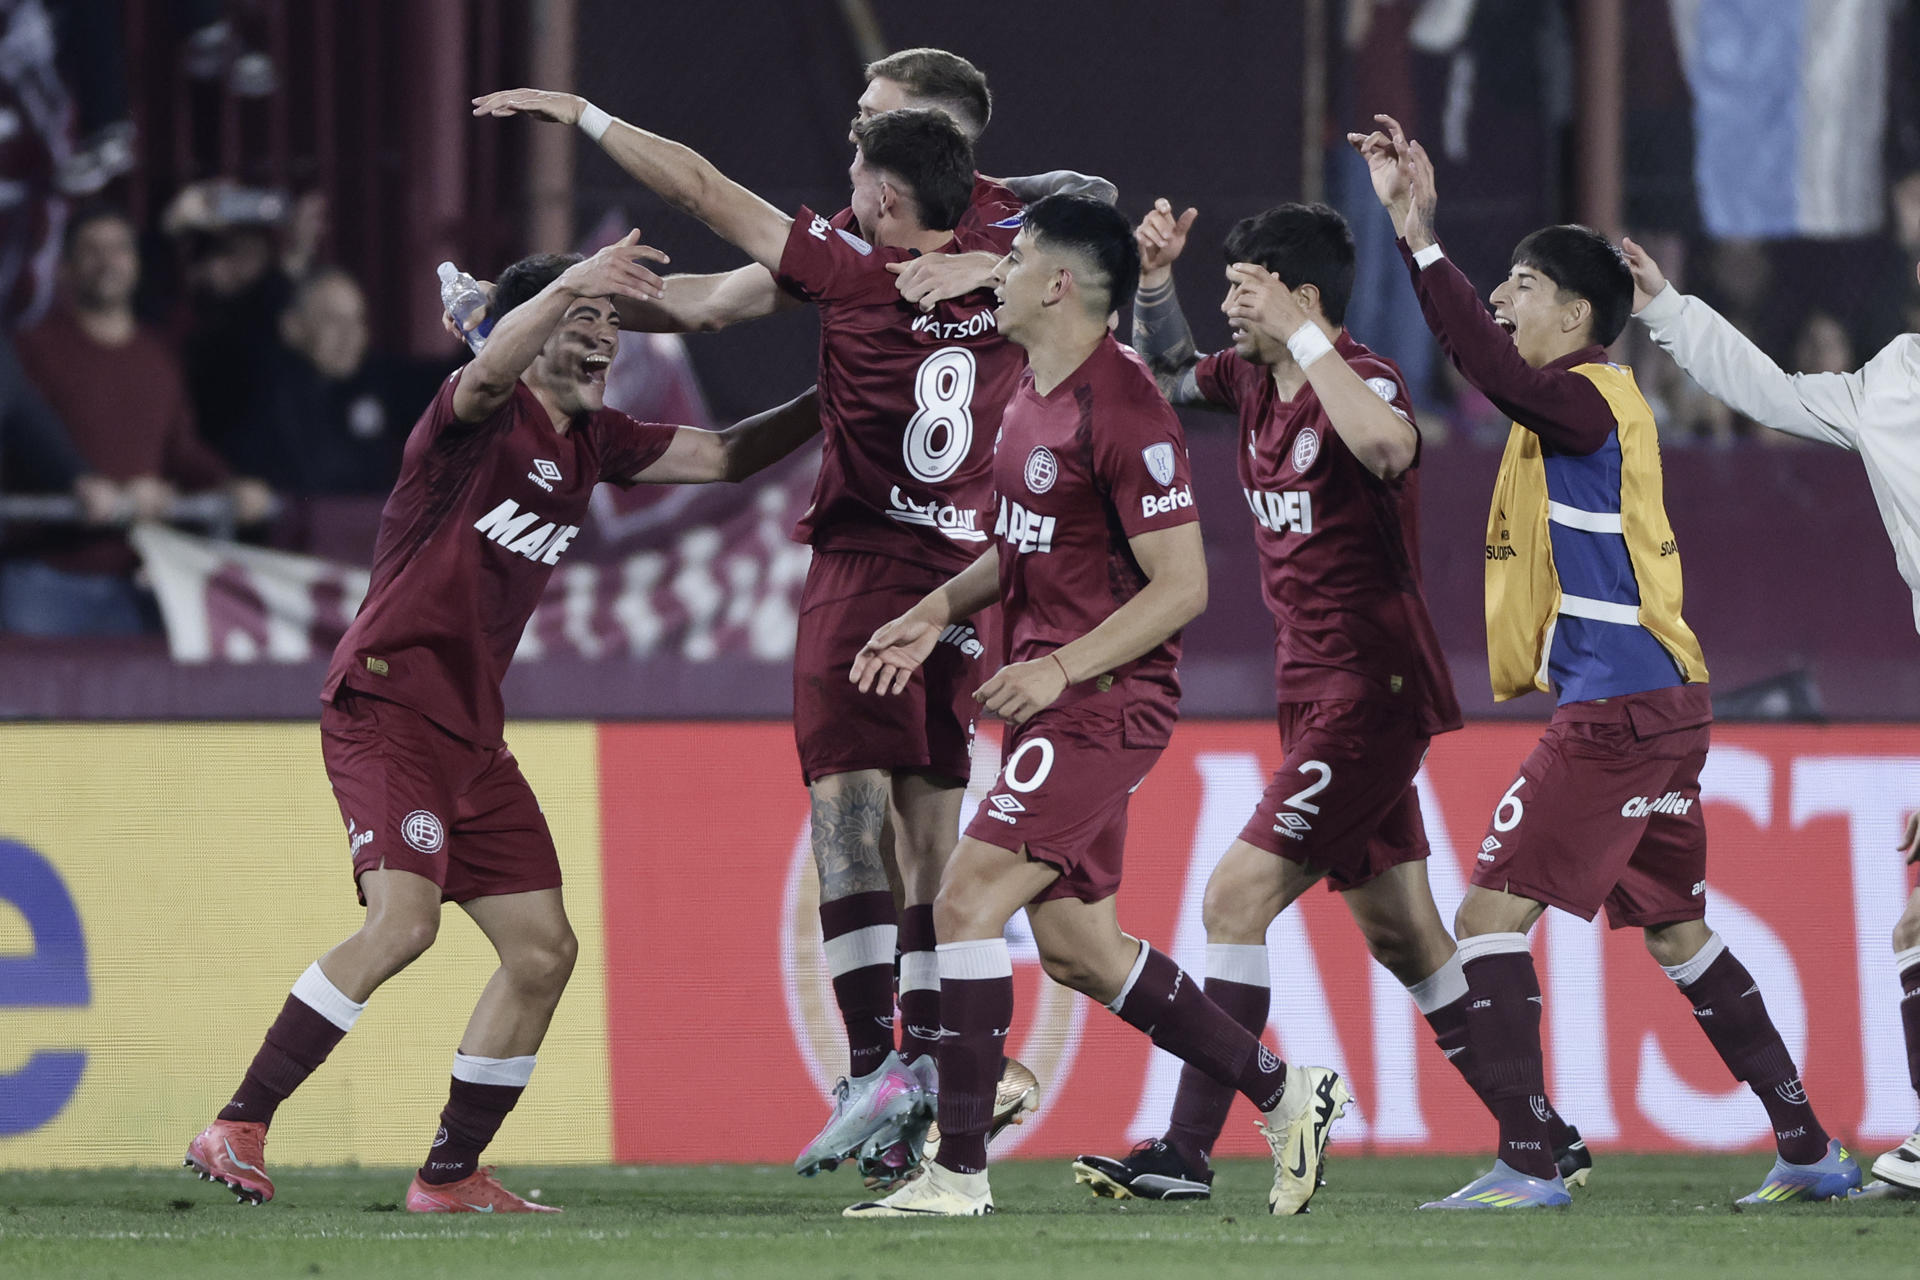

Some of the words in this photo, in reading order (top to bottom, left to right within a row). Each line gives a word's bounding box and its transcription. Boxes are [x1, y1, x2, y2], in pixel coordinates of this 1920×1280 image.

[911, 308, 996, 338] WATSON
[903, 346, 976, 483] 8
[527, 471, 553, 493] umbro
[1141, 484, 1193, 518] Befol
[993, 490, 1056, 554] APEI
[1282, 760, 1332, 815] 2
[987, 808, 1017, 825] umbro
[1272, 823, 1304, 841] umbro
[1262, 1081, 1287, 1108] TIFOX
[1777, 1126, 1807, 1141] TIFOX
[1508, 1141, 1542, 1151] TIFOX
[431, 1162, 464, 1170] TIFOX
